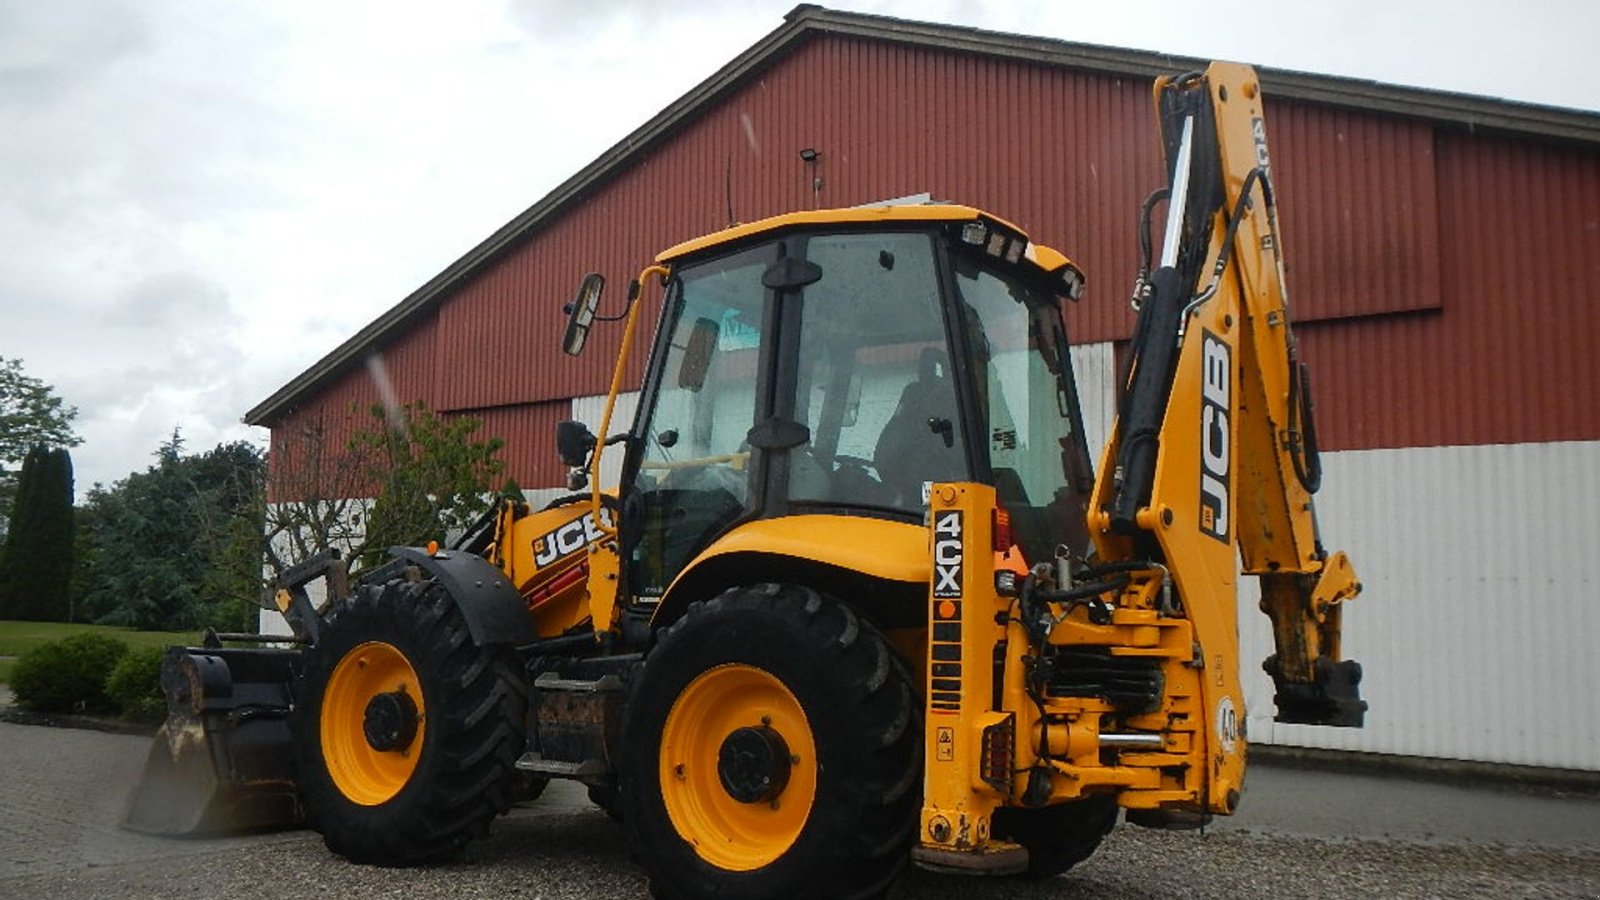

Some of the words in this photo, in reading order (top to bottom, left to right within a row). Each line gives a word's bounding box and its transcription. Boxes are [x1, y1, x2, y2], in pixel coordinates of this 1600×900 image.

[1203, 337, 1229, 536] JCB
[536, 507, 612, 566] JCB
[935, 512, 962, 591] 4CX
